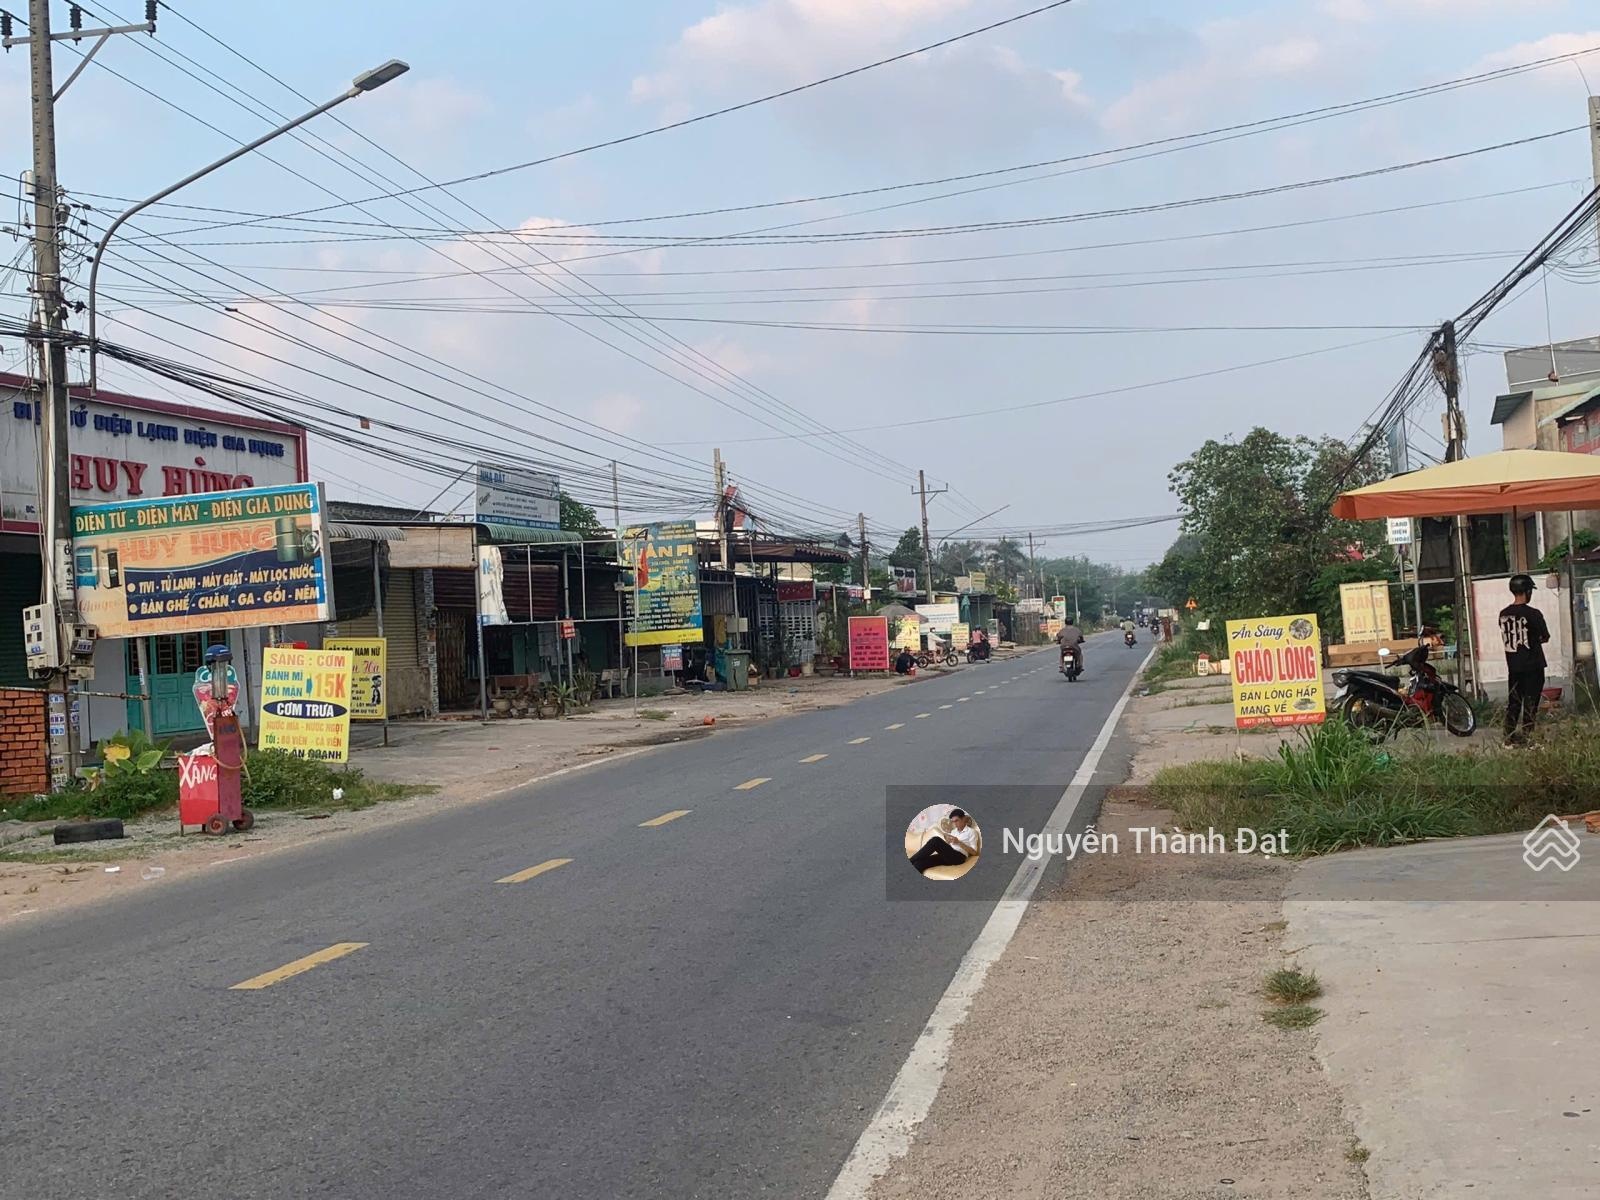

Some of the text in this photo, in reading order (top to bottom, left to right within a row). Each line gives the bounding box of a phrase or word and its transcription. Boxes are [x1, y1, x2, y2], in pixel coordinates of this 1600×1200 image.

[14, 401, 42, 425] ĐIỆ
[222, 434, 246, 451] GIA
[70, 453, 148, 495] HUY
[75, 493, 314, 535] ĐIỆN TỬ ĐIỆN MÁY ĐIỆN GIA DỤNG
[139, 581, 155, 594] TIVI
[174, 577, 197, 594] LẠNH
[202, 572, 221, 588] MÁY
[250, 567, 270, 583] MÁY
[140, 599, 164, 615] BÀN
[166, 593, 190, 611] GHẾ
[198, 592, 229, 609] CHĂN
[238, 592, 255, 606] GA
[263, 585, 286, 603] GỐI
[295, 585, 320, 603] NỆM
[1254, 624, 1285, 640] Sáng
[316, 655, 346, 667] CƠM
[354, 647, 369, 657] NAM
[1234, 639, 1317, 684] CHÁO LÒNG
[265, 670, 289, 680] BÁNH
[315, 673, 347, 698] 15K
[276, 702, 335, 717] CƠM TRƯA
[1240, 704, 1271, 716] MANG
[178, 756, 217, 789] XĂNG
